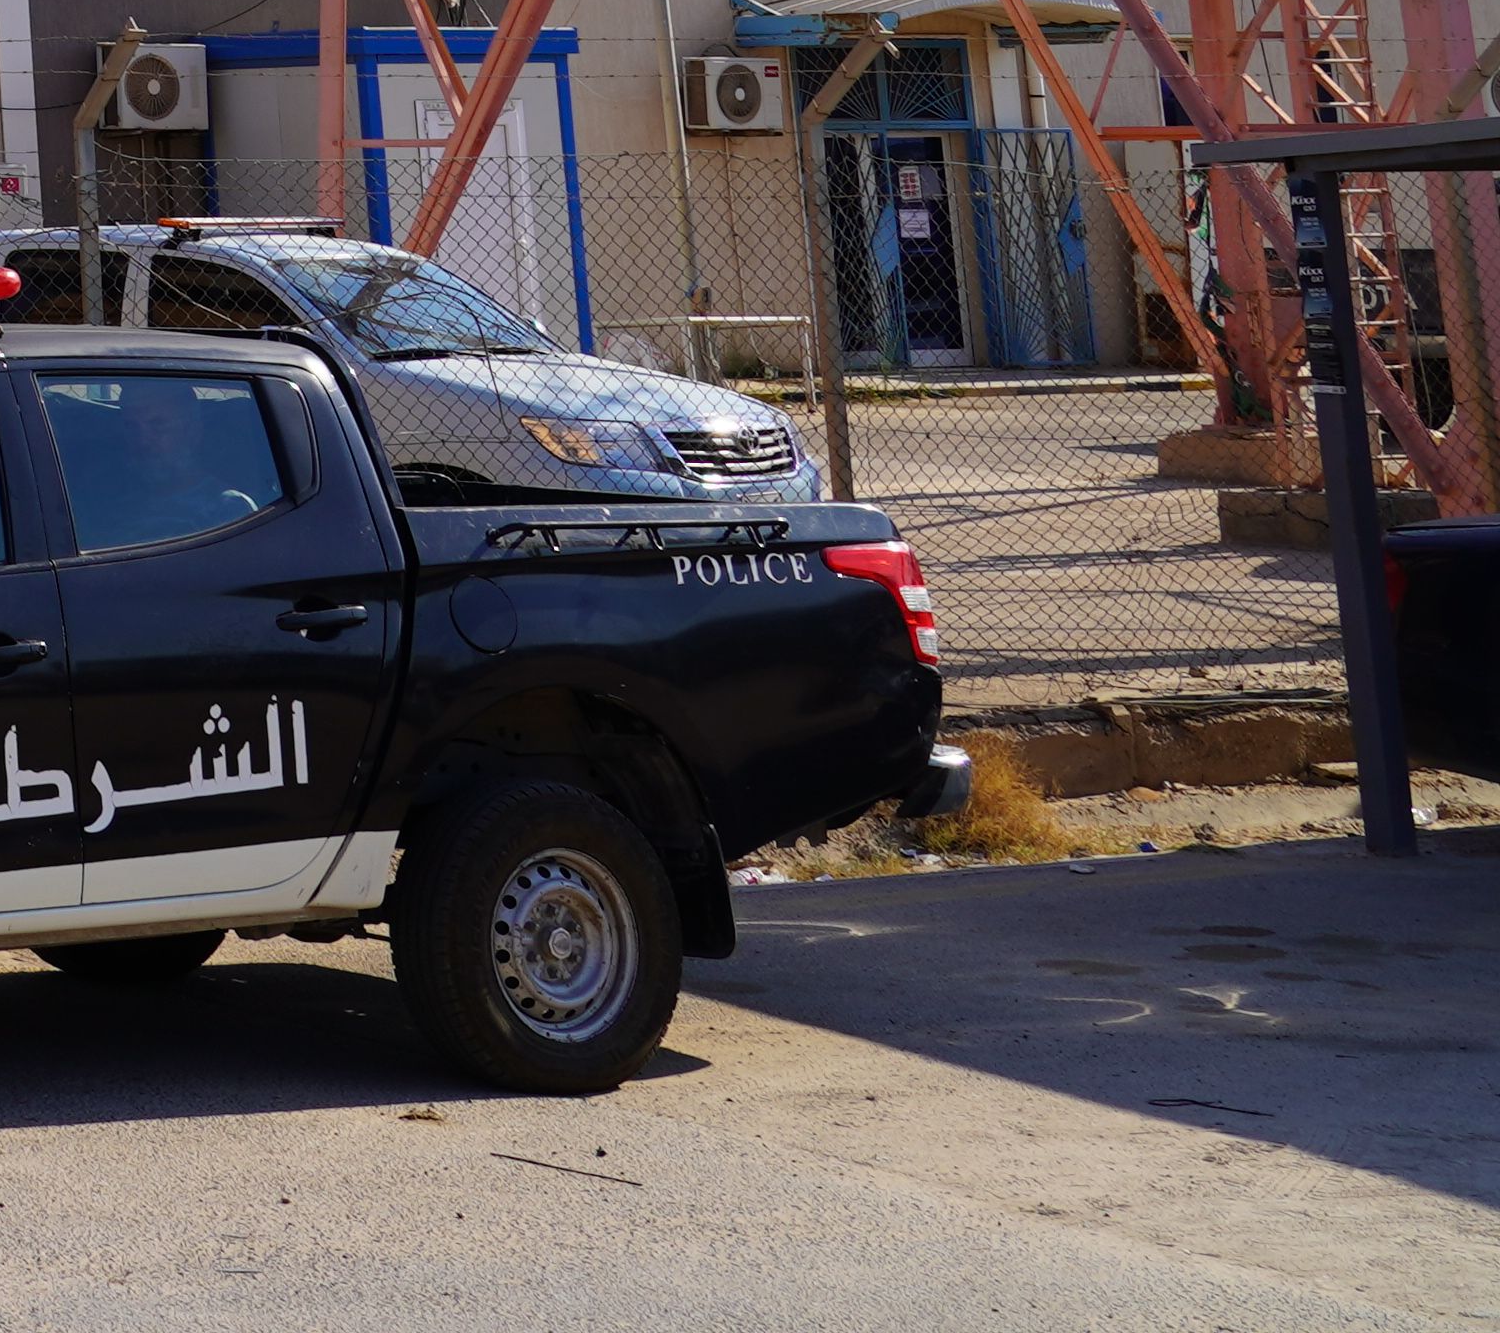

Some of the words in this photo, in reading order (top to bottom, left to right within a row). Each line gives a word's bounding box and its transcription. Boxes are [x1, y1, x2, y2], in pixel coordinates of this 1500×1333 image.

[1291, 196, 1317, 206] Kixx
[1299, 266, 1324, 276] Kixx
[671, 552, 813, 587] POLICE
